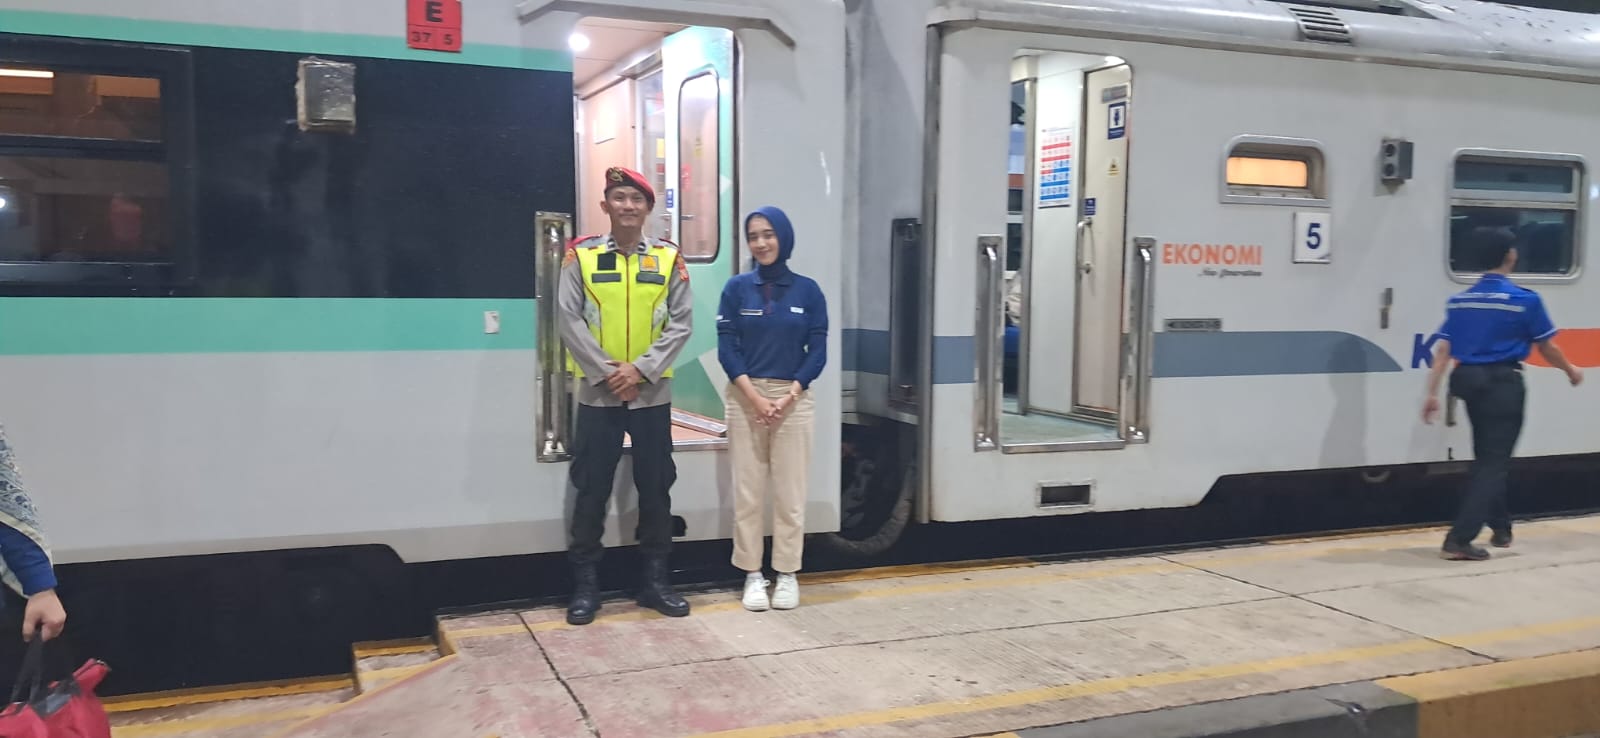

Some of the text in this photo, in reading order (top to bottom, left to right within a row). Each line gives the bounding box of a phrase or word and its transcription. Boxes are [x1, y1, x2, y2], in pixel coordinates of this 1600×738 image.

[425, 1, 443, 22] E
[1306, 222, 1321, 250] 5
[1162, 243, 1263, 265] EKONOMI
